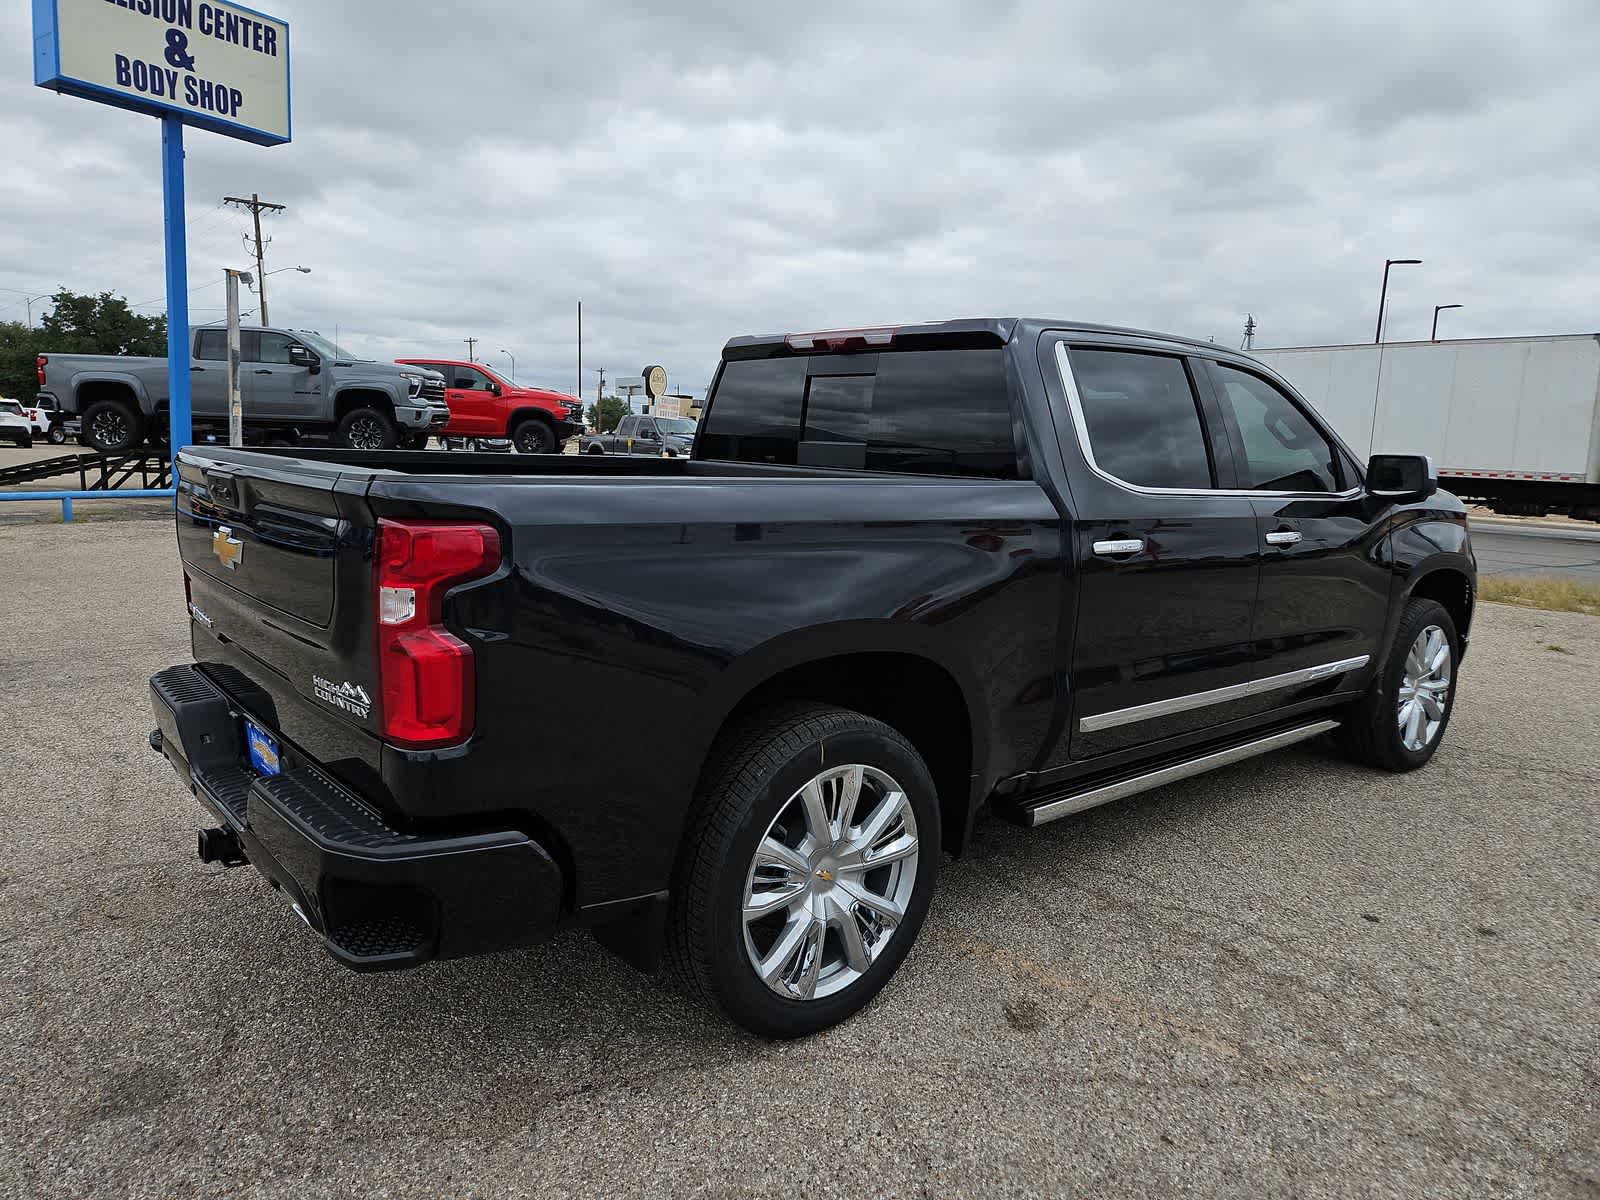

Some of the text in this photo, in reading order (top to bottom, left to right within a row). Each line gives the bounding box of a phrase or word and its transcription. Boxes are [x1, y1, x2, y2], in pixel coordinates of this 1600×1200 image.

[164, 27, 196, 73] &
[198, 3, 278, 57] CENTER
[114, 53, 244, 118] BODY SHOP
[312, 674, 341, 695] HIGH
[314, 686, 370, 719] COUNTRY
